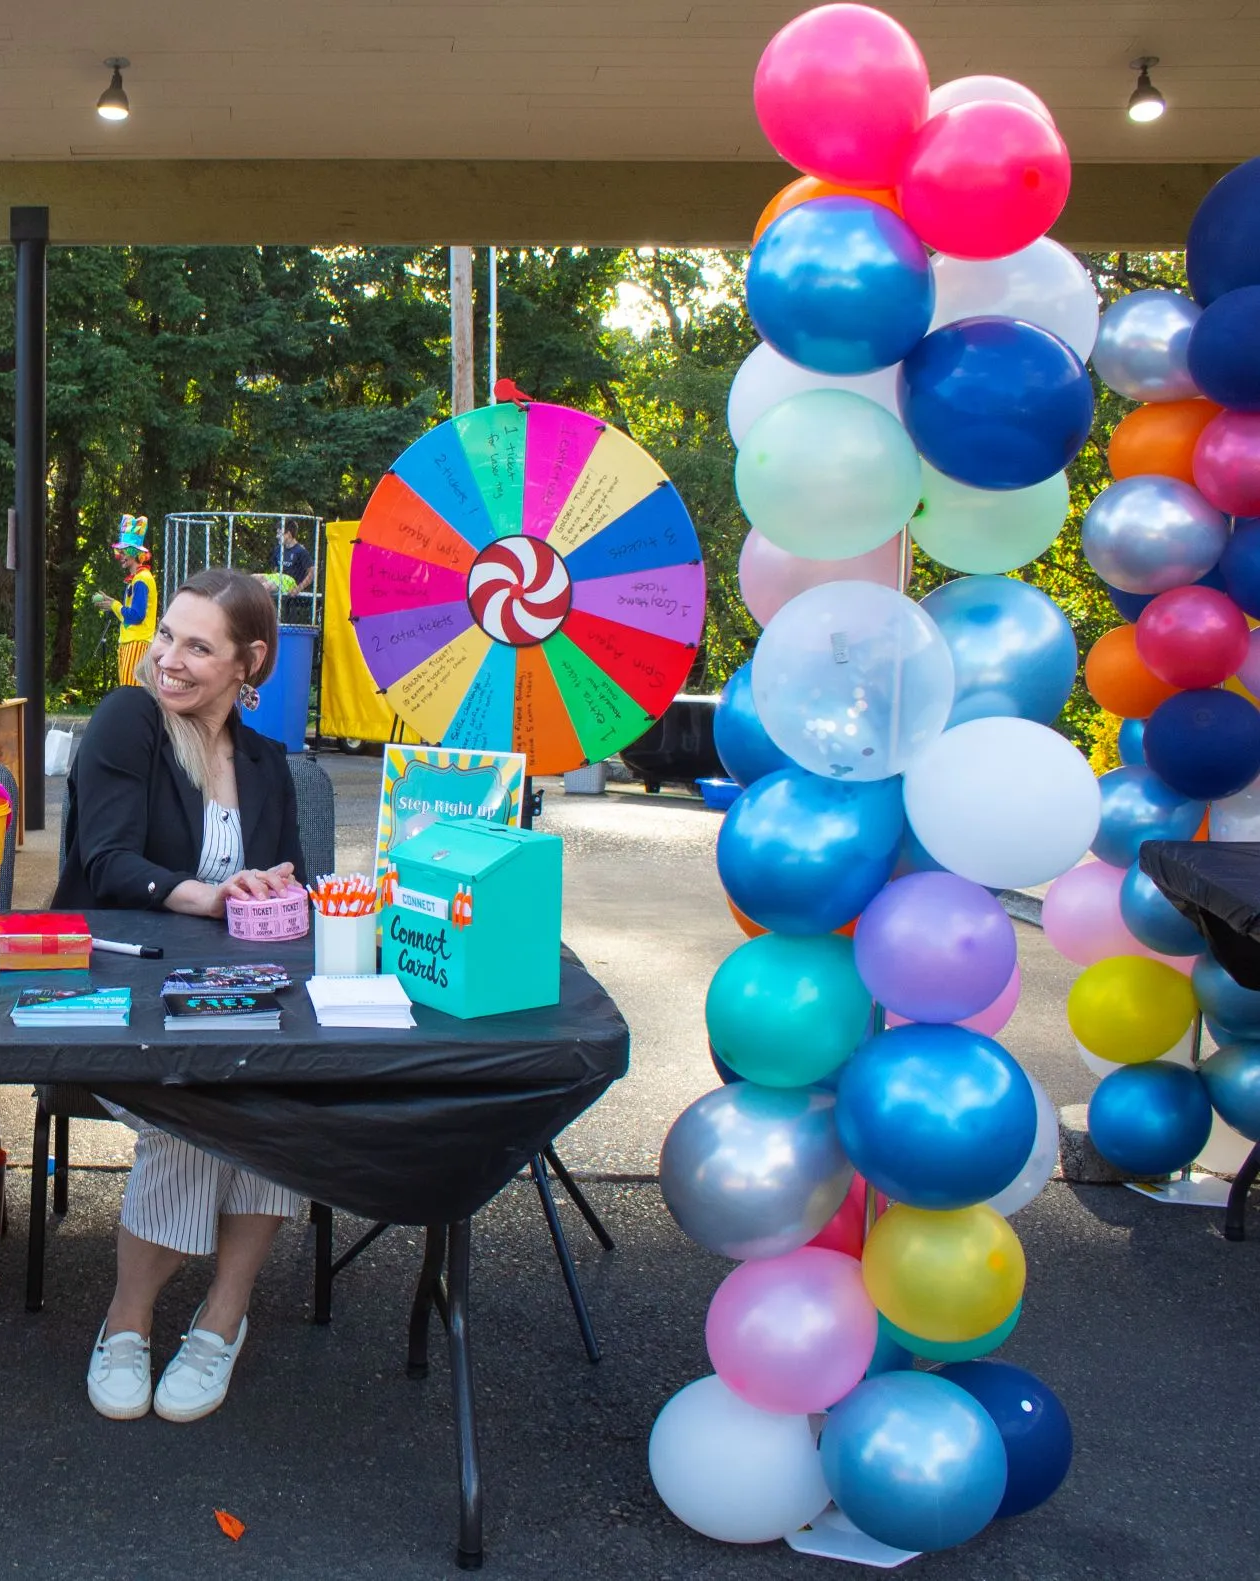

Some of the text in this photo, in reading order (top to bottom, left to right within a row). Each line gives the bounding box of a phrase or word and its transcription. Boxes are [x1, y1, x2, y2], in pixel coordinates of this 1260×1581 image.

[488, 433, 500, 449] for
[434, 453, 447, 468] 2
[504, 426, 518, 481] 1 ticket
[555, 504, 575, 533] GOLDEN
[609, 527, 677, 560] 3 tickets
[631, 583, 668, 592] ticket
[681, 605, 692, 617] 1
[372, 615, 454, 652] 2 extra tickets
[588, 631, 666, 689] Spin Again
[402, 669, 428, 694] GOLDEN
[561, 660, 617, 742] 1 extra ticket
[398, 796, 430, 815] Step
[434, 800, 473, 816] Right
[230, 906, 244, 914] TICKET
[252, 906, 273, 916] TICKET
[282, 902, 299, 912] TICKET
[402, 893, 436, 913] CONNECT
[391, 915, 452, 960] Connect
[398, 949, 449, 988] Cards
